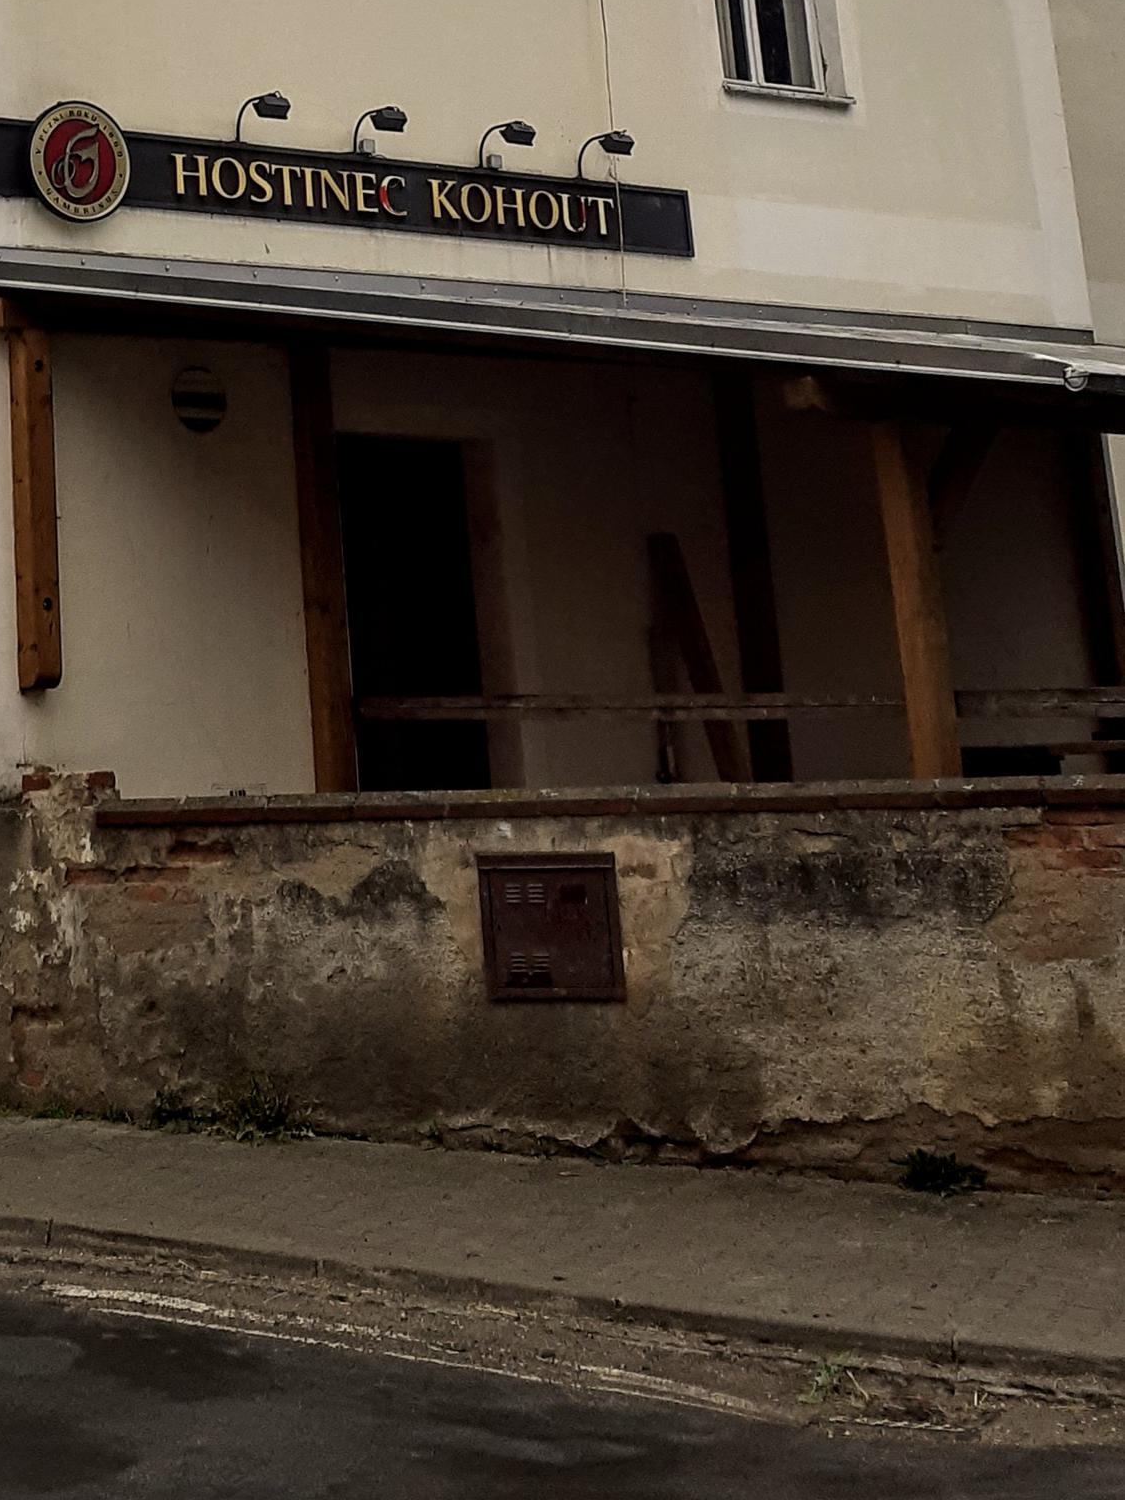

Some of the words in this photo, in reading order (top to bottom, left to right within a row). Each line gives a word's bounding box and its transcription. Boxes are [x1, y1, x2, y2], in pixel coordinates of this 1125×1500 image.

[69, 109, 98, 121] ROKU
[46, 187, 119, 215] GAMBRINUS
[170, 152, 408, 217] HOSTINEC
[428, 178, 615, 236] KOHOUT
